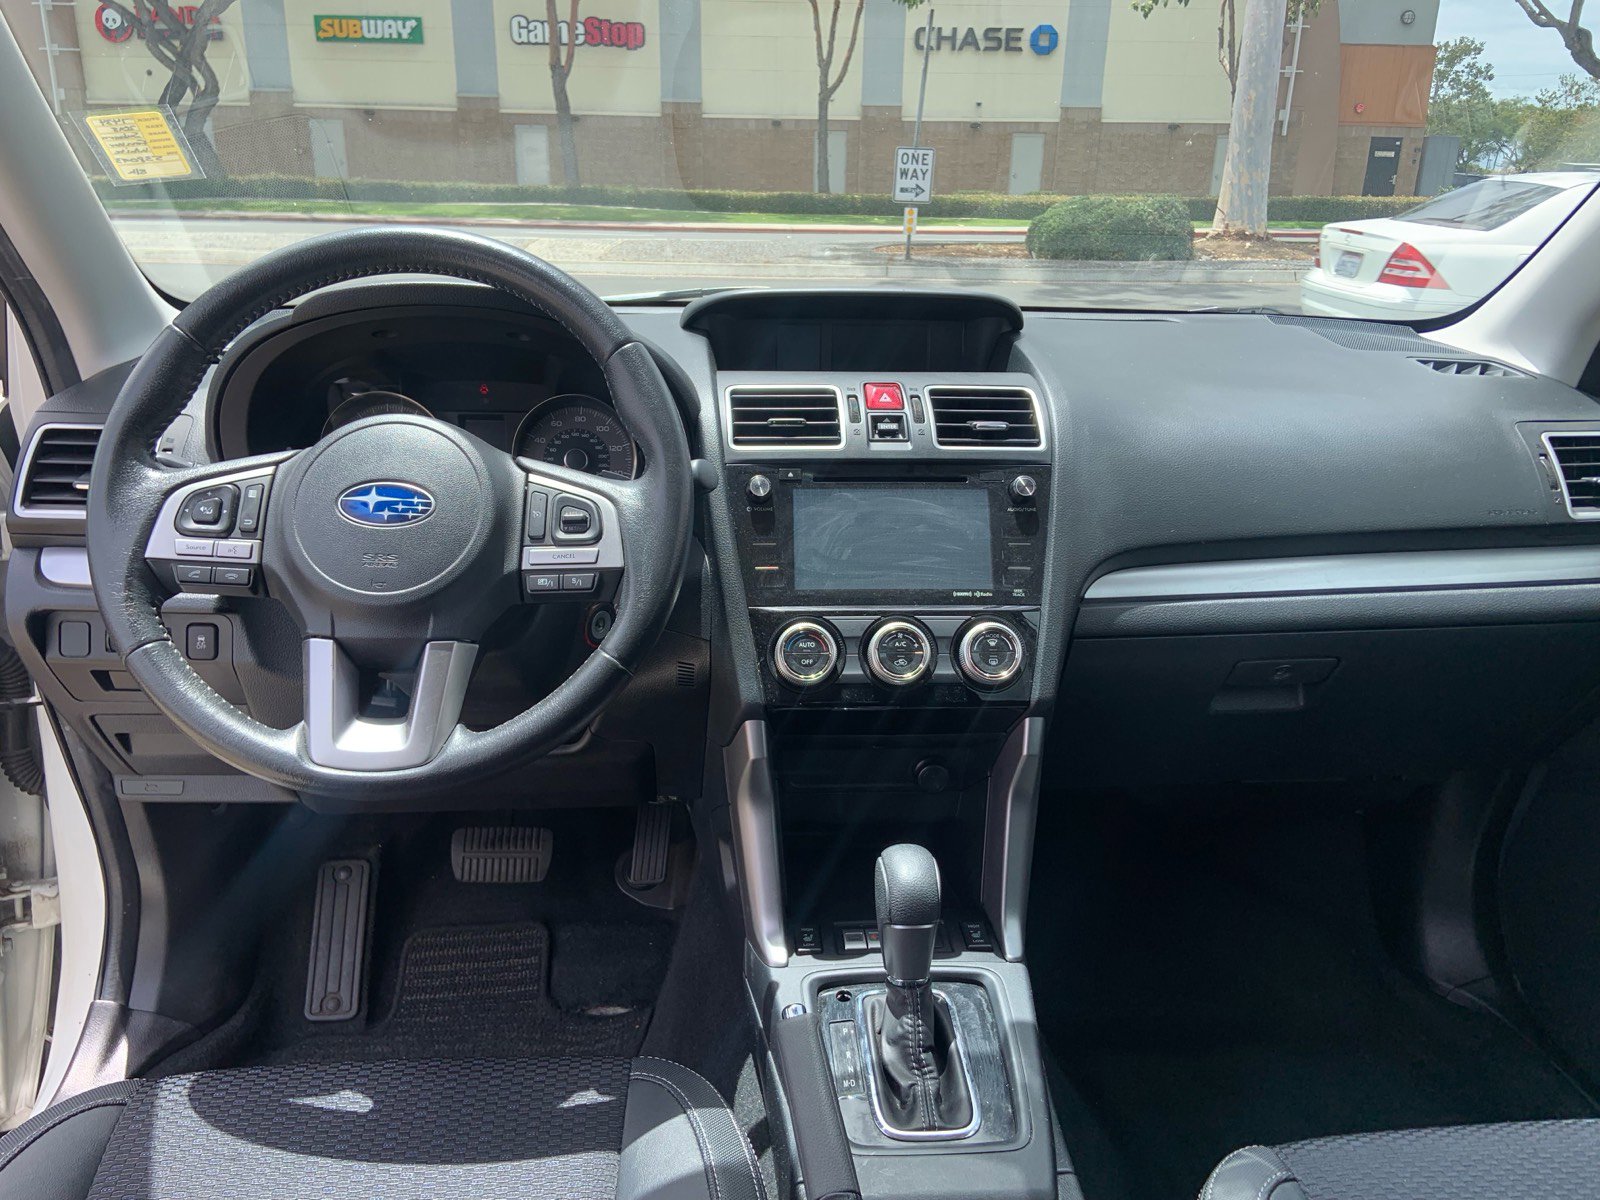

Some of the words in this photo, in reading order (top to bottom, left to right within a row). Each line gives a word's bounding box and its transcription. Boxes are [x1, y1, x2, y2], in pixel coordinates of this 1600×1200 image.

[318, 18, 417, 39] SUBWAY
[510, 15, 645, 50] GameStop
[914, 27, 1024, 52] CHASE
[901, 152, 930, 166] ONE
[899, 168, 929, 181] WAY
